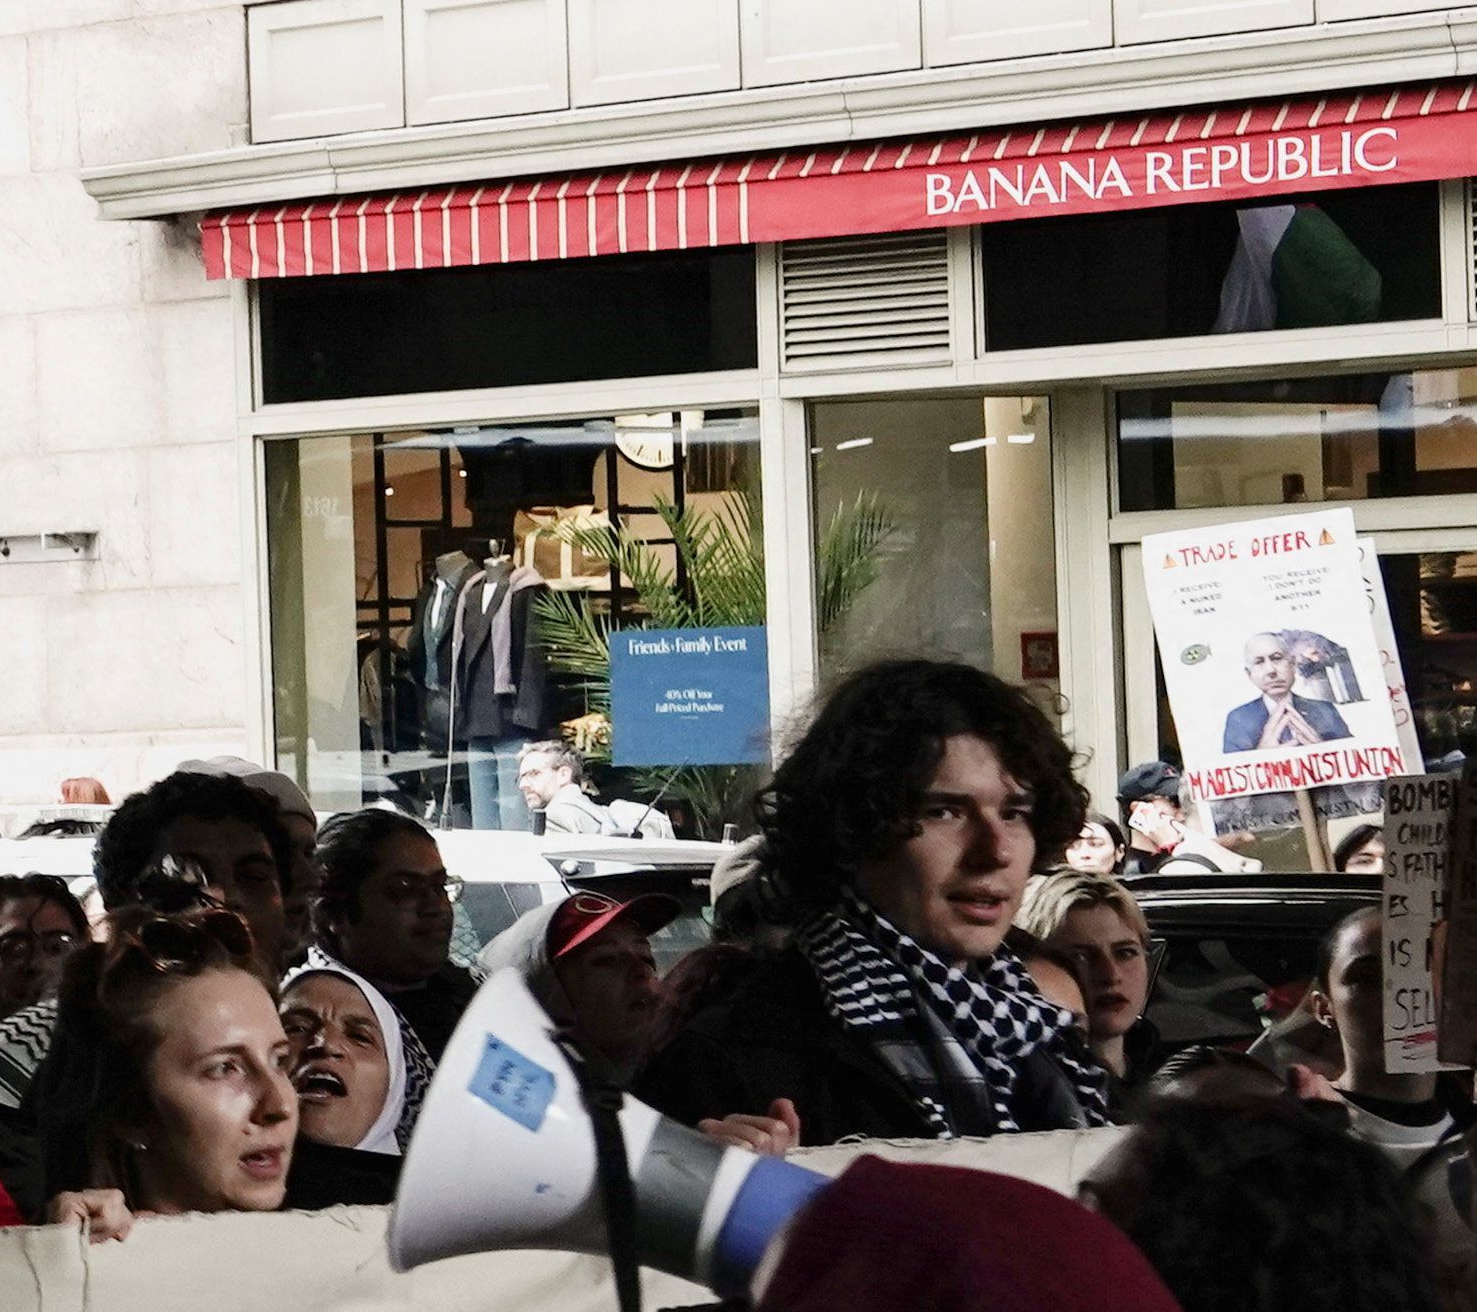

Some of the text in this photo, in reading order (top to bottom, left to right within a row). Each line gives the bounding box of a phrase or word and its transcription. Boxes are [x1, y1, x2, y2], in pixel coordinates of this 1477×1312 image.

[925, 127, 1398, 215] BANANA REPUBLIC
[1179, 530, 1312, 567] TRADE OFFER
[628, 635, 748, 656] Friends Family Event
[1344, 747, 1407, 779] UNION
[1389, 779, 1451, 815] BOMB
[1397, 823, 1445, 846] CHILD
[1390, 988, 1436, 1030] SEL
